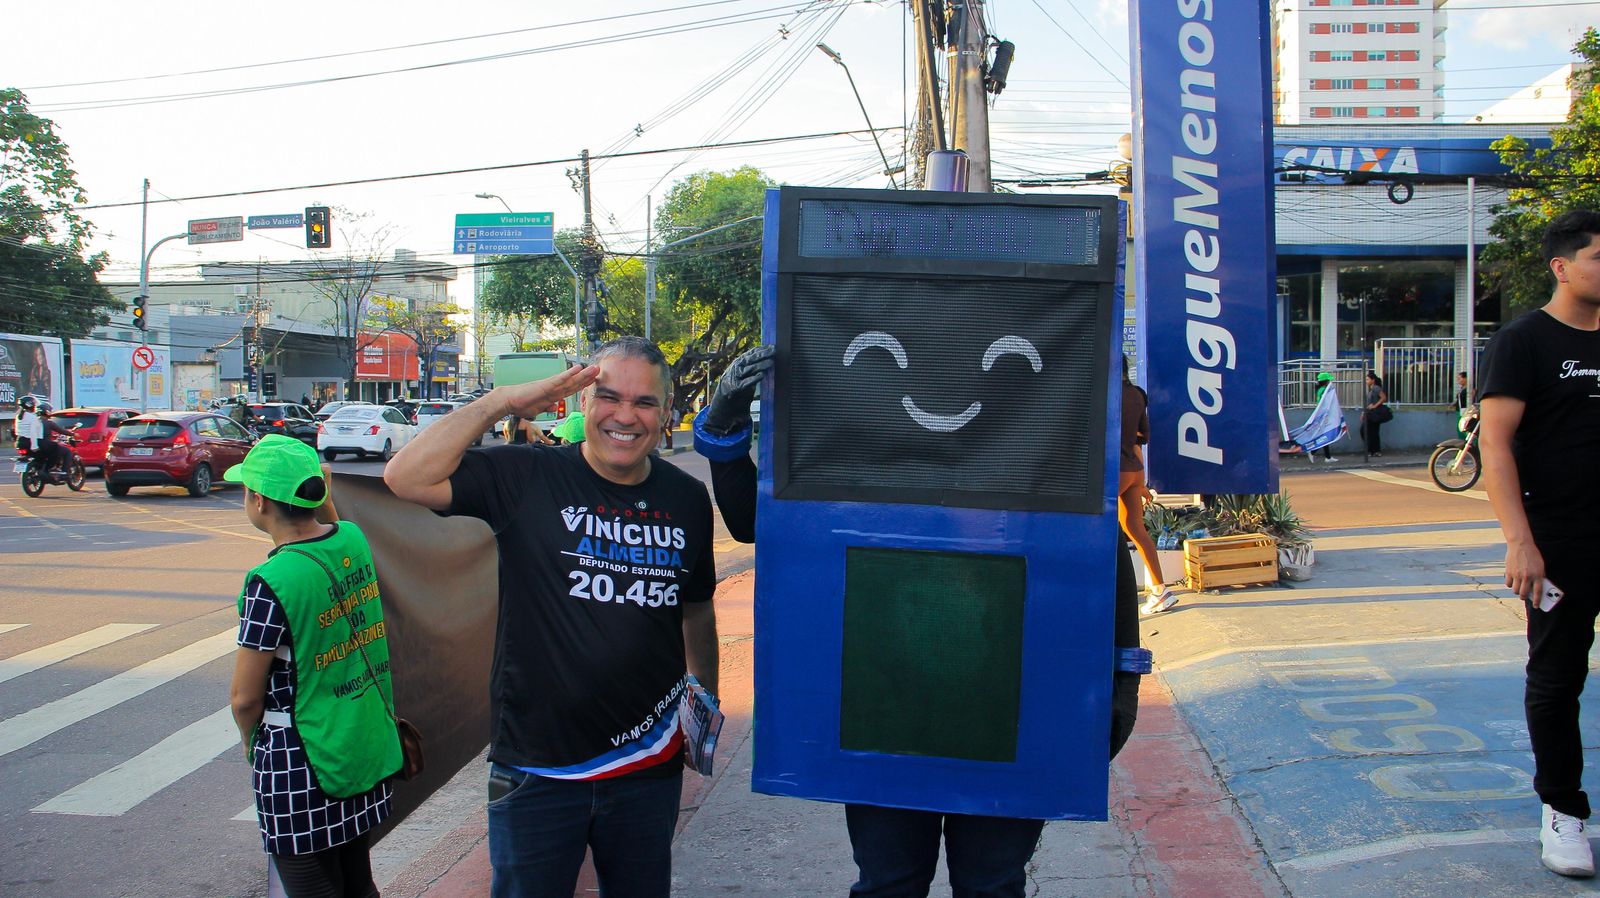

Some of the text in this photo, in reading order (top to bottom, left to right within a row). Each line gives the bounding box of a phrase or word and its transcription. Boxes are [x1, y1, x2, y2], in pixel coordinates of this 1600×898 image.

[1281, 146, 1420, 174] CAIXA
[191, 223, 217, 233] NUNCA
[251, 215, 300, 227] João Valério
[500, 216, 541, 224] Vieiralves
[823, 210, 1032, 254] PAREDINHO
[1173, 0, 1237, 466] PagueMenos
[479, 244, 520, 252] Aeroporto
[1560, 360, 1600, 382] Tomm
[561, 506, 686, 550] VINÍCIUS
[576, 536, 683, 568] ALMEIDA
[579, 557, 676, 578] DEPUTADO ESTADUAL
[568, 570, 680, 608] 20.456
[333, 676, 364, 698] VAMOS
[611, 713, 655, 747] VAMOS
